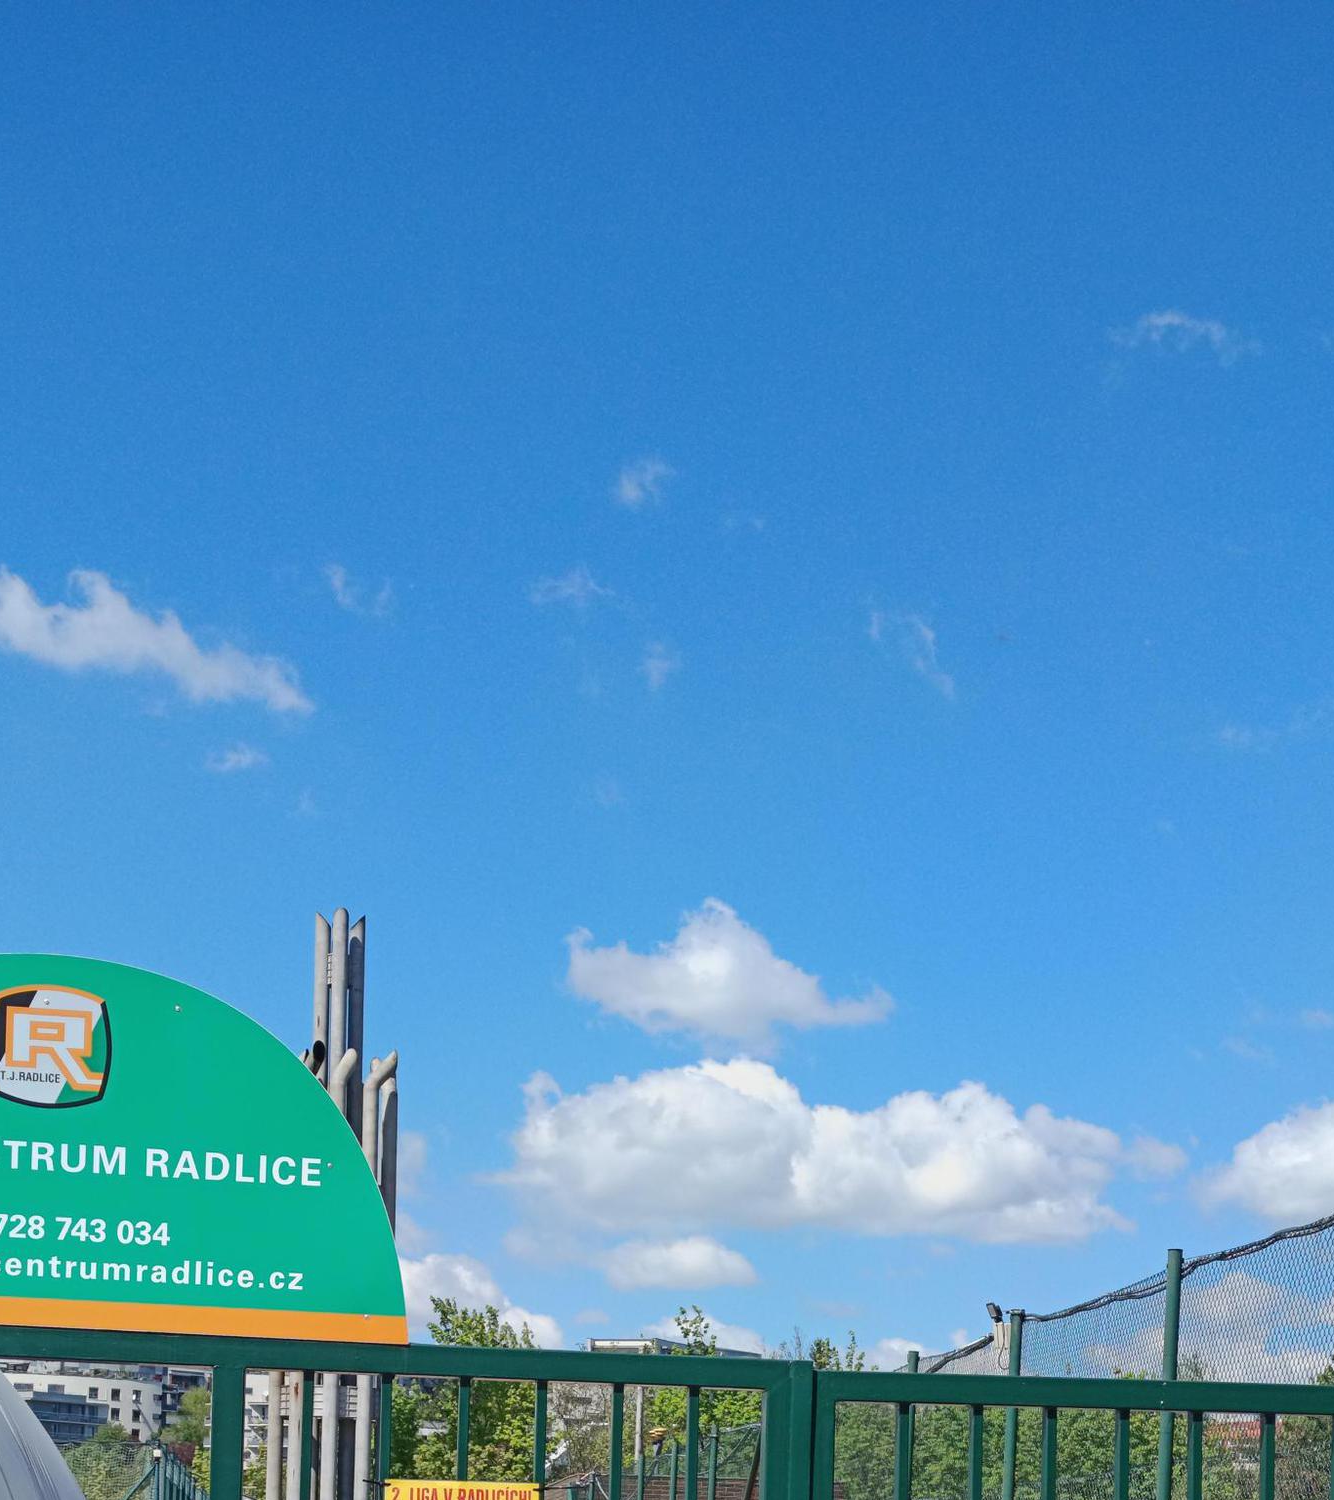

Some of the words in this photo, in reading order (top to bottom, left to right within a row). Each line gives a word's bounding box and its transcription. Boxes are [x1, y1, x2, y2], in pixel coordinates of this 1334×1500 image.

[145, 1147, 322, 1187] RADLICE
[55, 1216, 106, 1242] 743
[117, 1219, 171, 1246] 034
